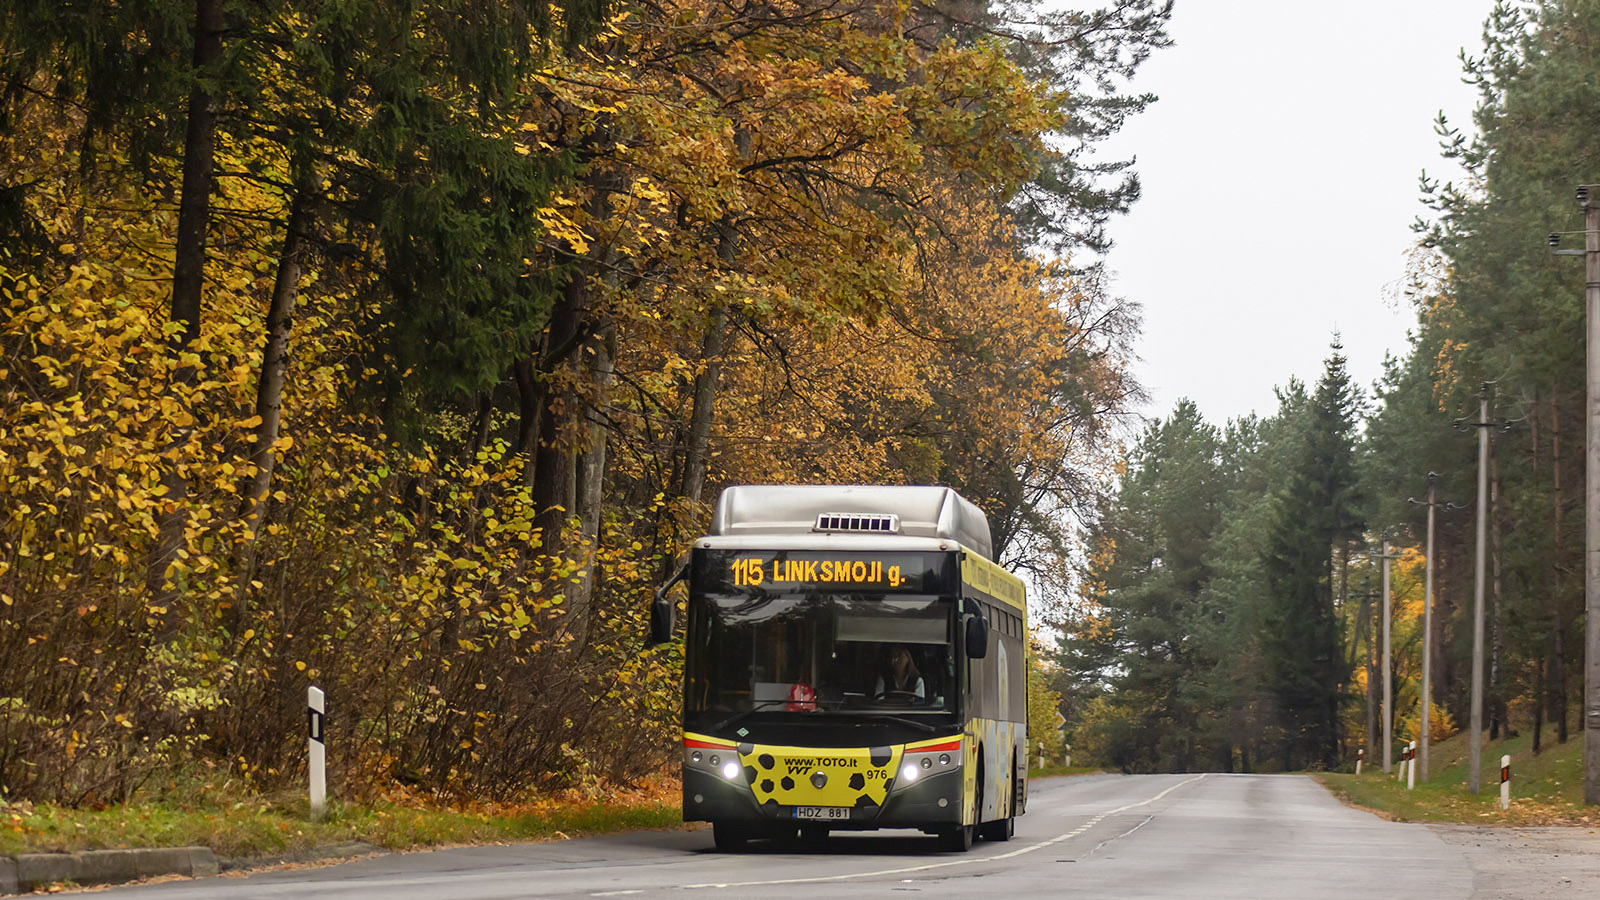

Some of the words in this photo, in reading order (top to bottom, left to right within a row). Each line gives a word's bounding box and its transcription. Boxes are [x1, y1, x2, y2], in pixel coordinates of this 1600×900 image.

[731, 558, 764, 586] 115
[773, 560, 882, 582] LINKSMOJI
[888, 565, 906, 587] g.
[867, 770, 887, 779] 976
[798, 807, 821, 817] HDZ
[829, 808, 847, 817] 881
